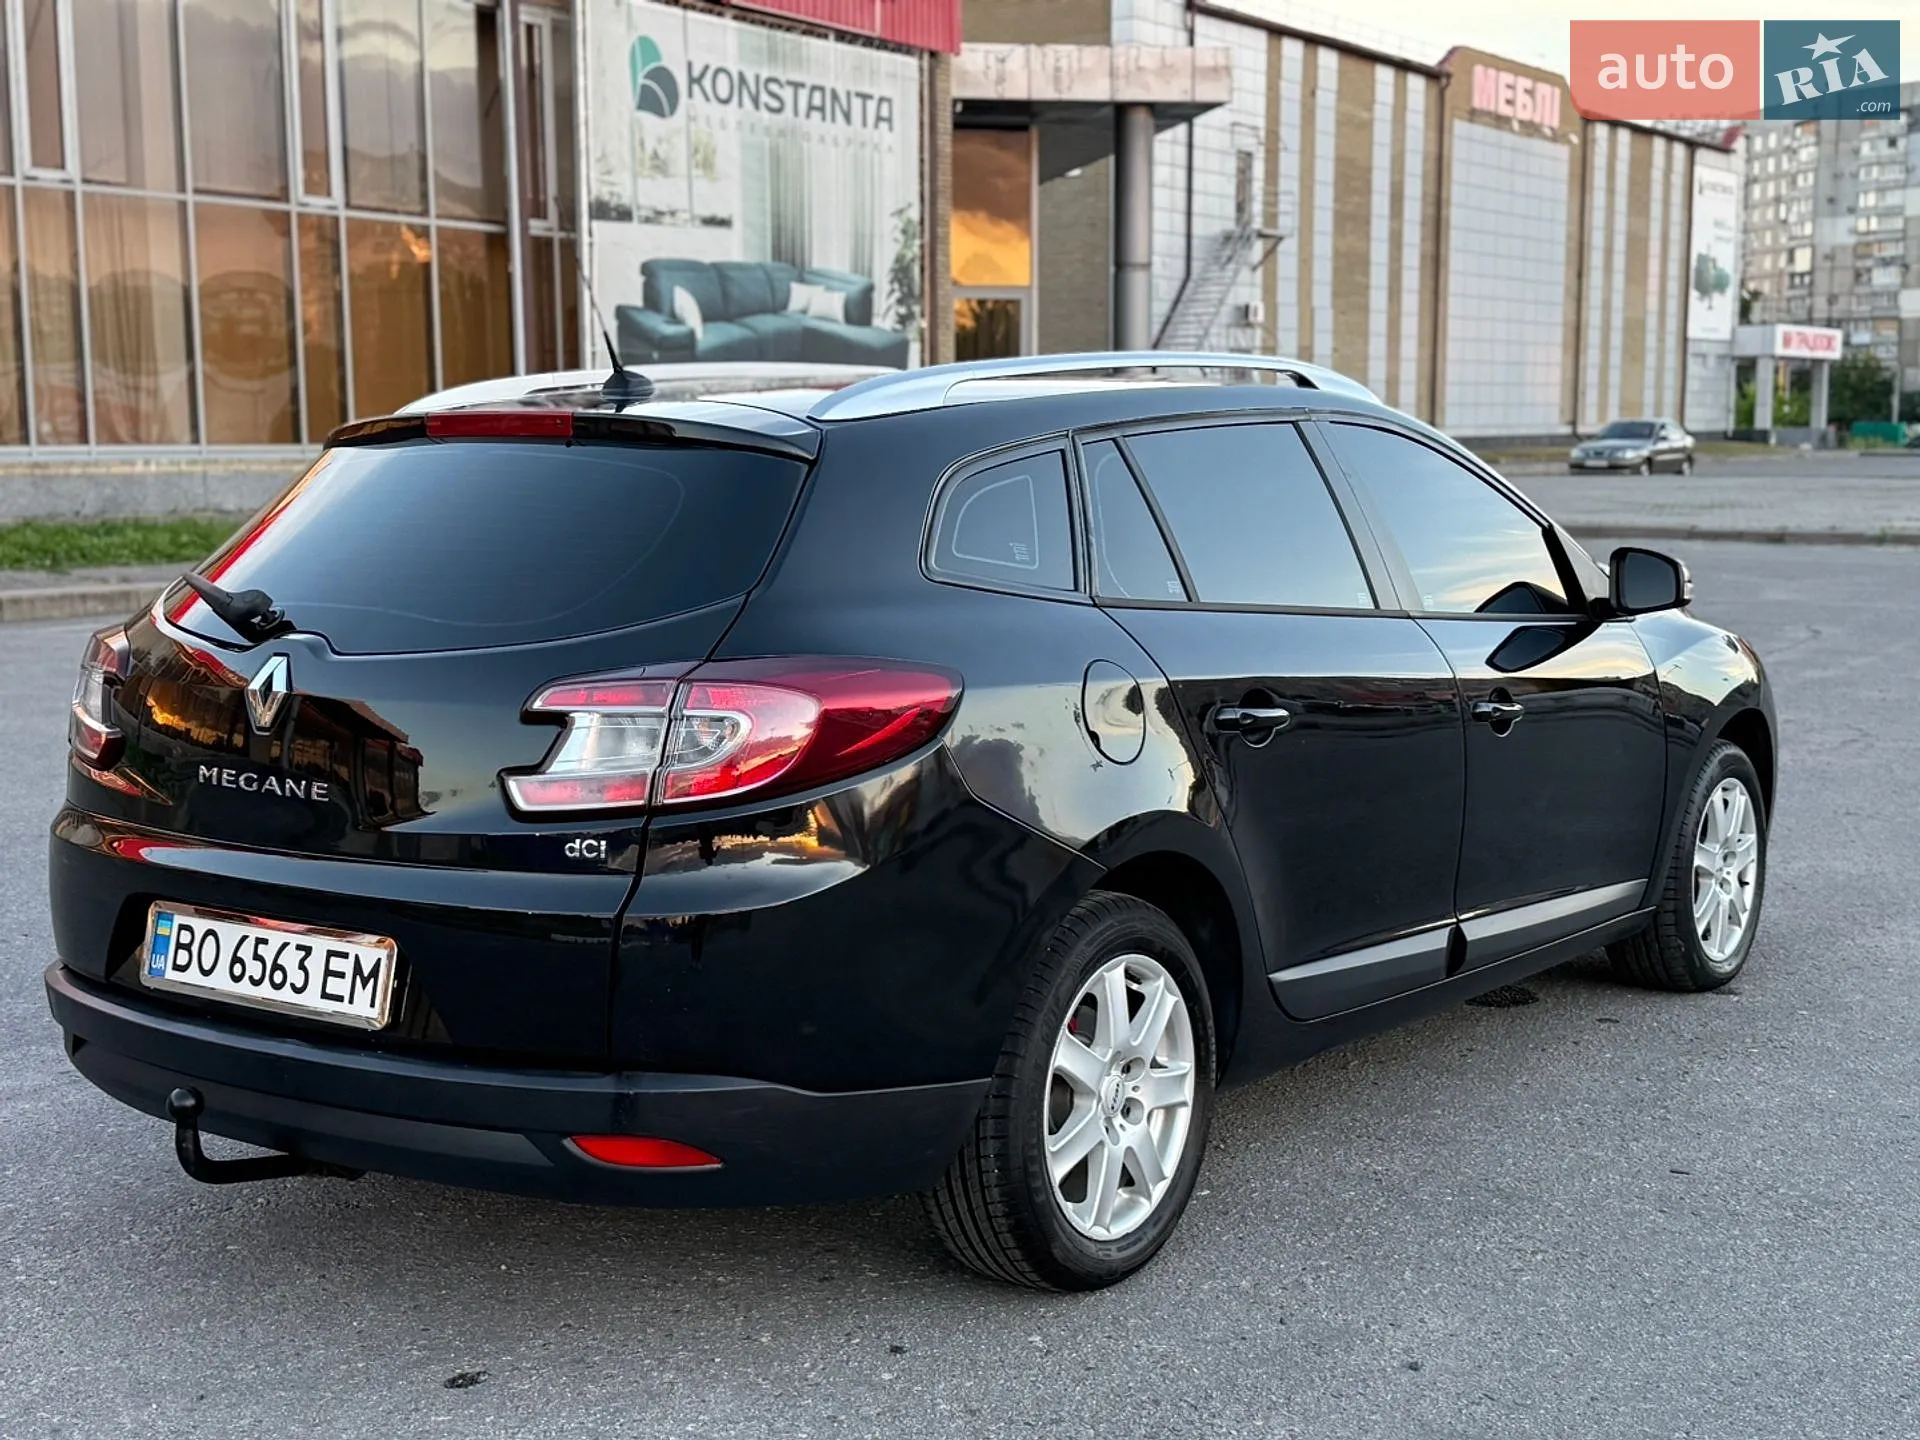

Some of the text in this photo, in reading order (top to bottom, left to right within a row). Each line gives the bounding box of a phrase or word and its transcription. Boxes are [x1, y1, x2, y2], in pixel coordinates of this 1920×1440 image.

[687, 60, 893, 132] KONSTANTA
[198, 765, 329, 802] MEGANE
[151, 953, 166, 970] UA
[172, 923, 382, 1008] BO 6563 EM
